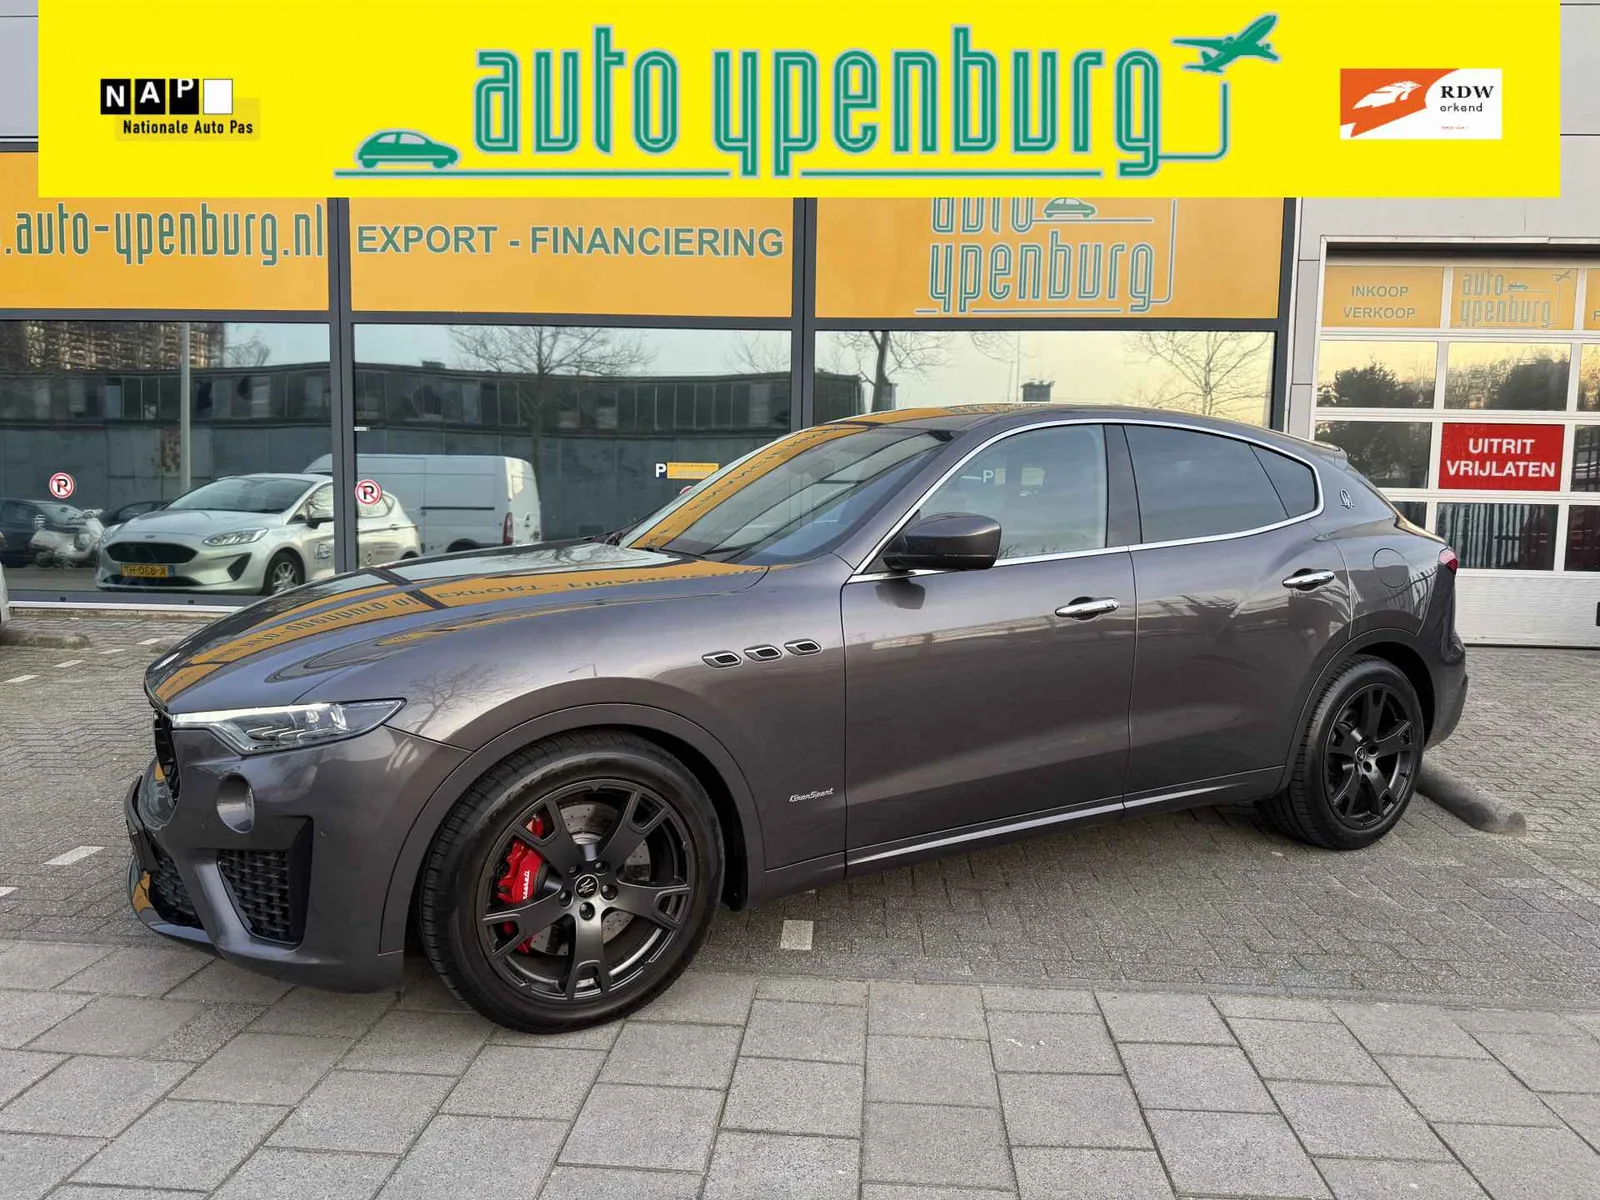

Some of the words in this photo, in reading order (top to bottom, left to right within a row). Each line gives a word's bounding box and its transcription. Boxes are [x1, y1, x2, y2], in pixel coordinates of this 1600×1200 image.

[356, 224, 498, 254] EXPORT
[529, 226, 785, 258] FINANCIERING
[929, 230, 1155, 313] ypenburg
[1351, 285, 1409, 298] INKOOP
[1461, 269, 1504, 296] auto
[1343, 306, 1416, 319] VERKOOP
[1461, 295, 1551, 328] ypenburg
[1468, 437, 1536, 455] UITRIT
[655, 463, 667, 478] P
[1446, 459, 1556, 478] VRIJLATEN
